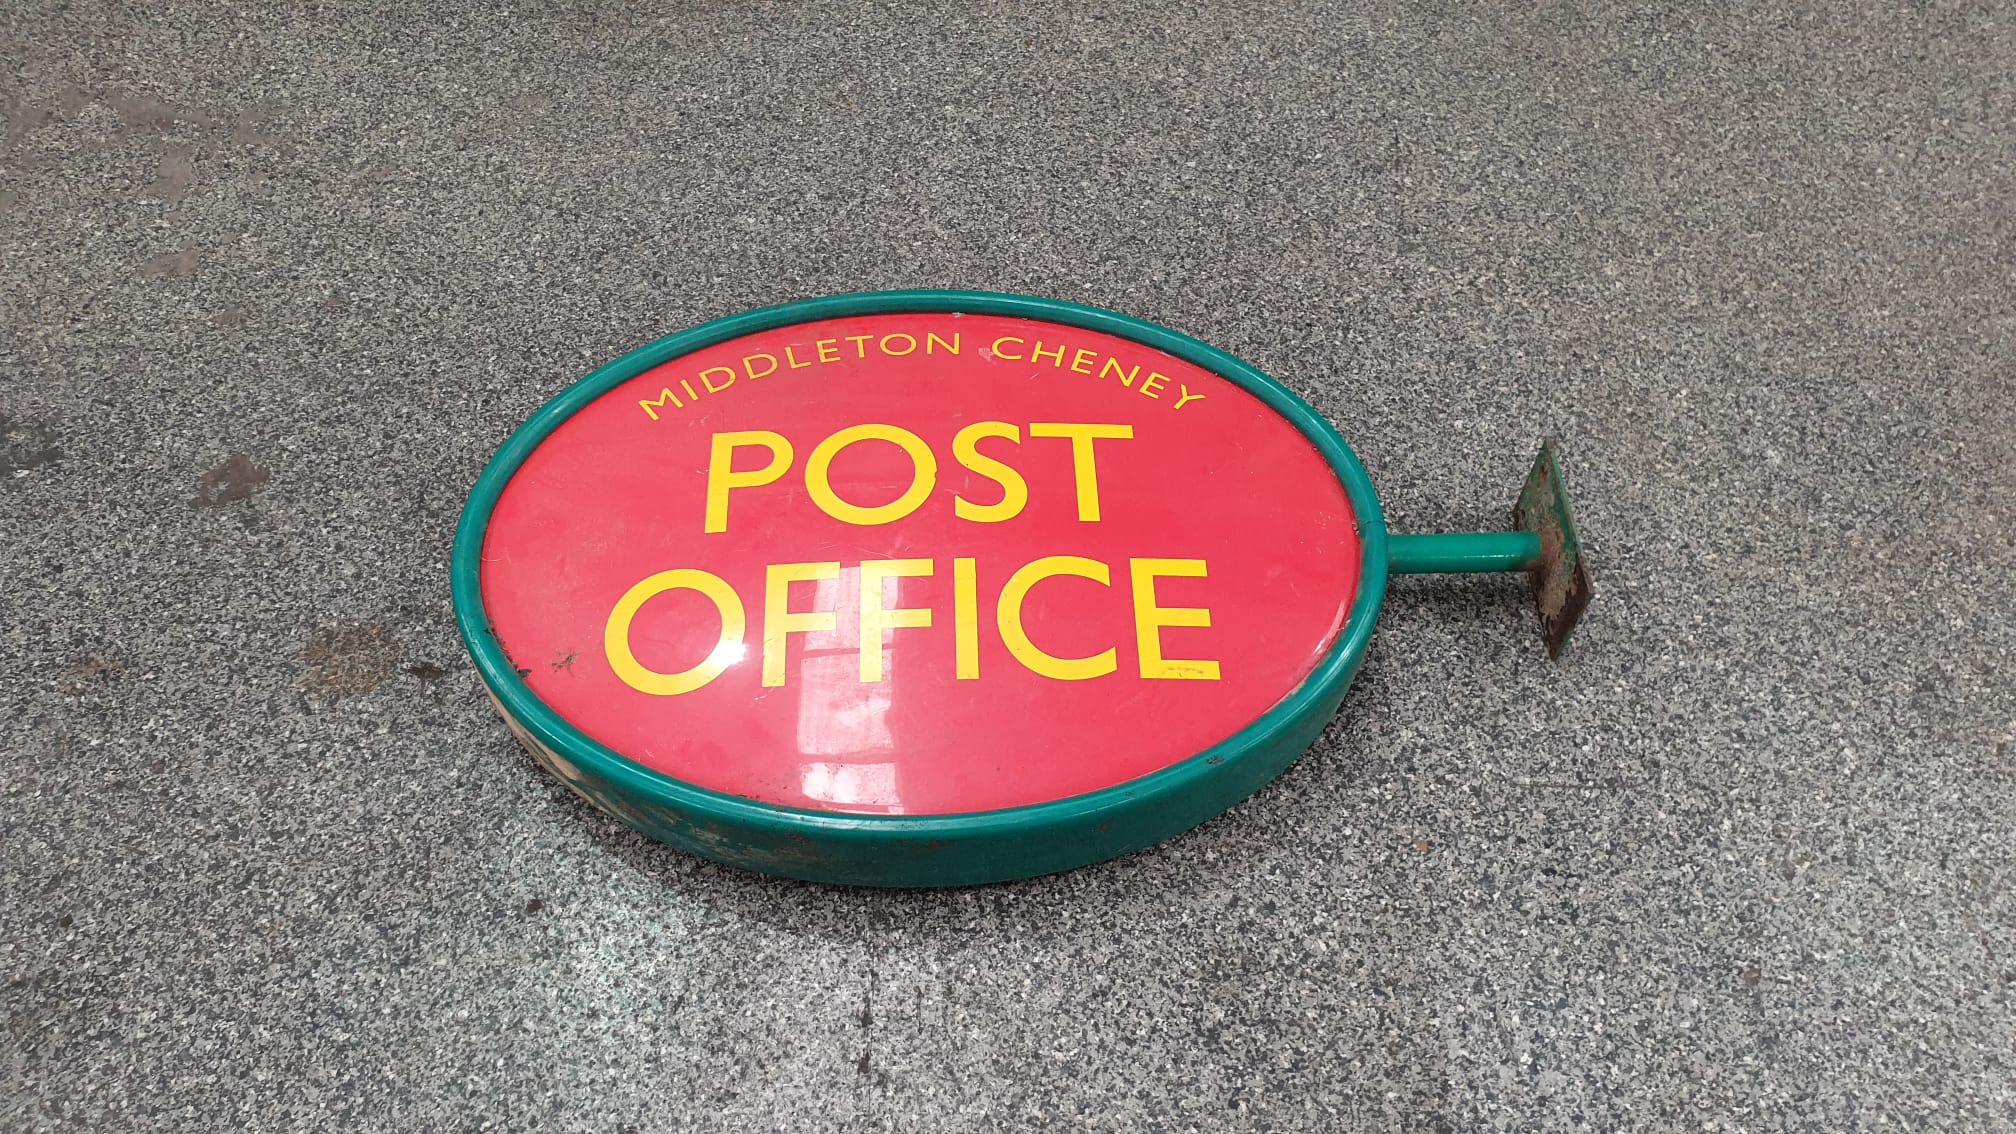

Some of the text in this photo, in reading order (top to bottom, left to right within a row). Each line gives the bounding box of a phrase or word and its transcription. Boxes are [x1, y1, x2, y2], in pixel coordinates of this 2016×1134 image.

[638, 332, 1206, 421] MIDDLETON CHENEY
[704, 421, 1134, 534] POST
[604, 556, 1221, 696] OFFICE
